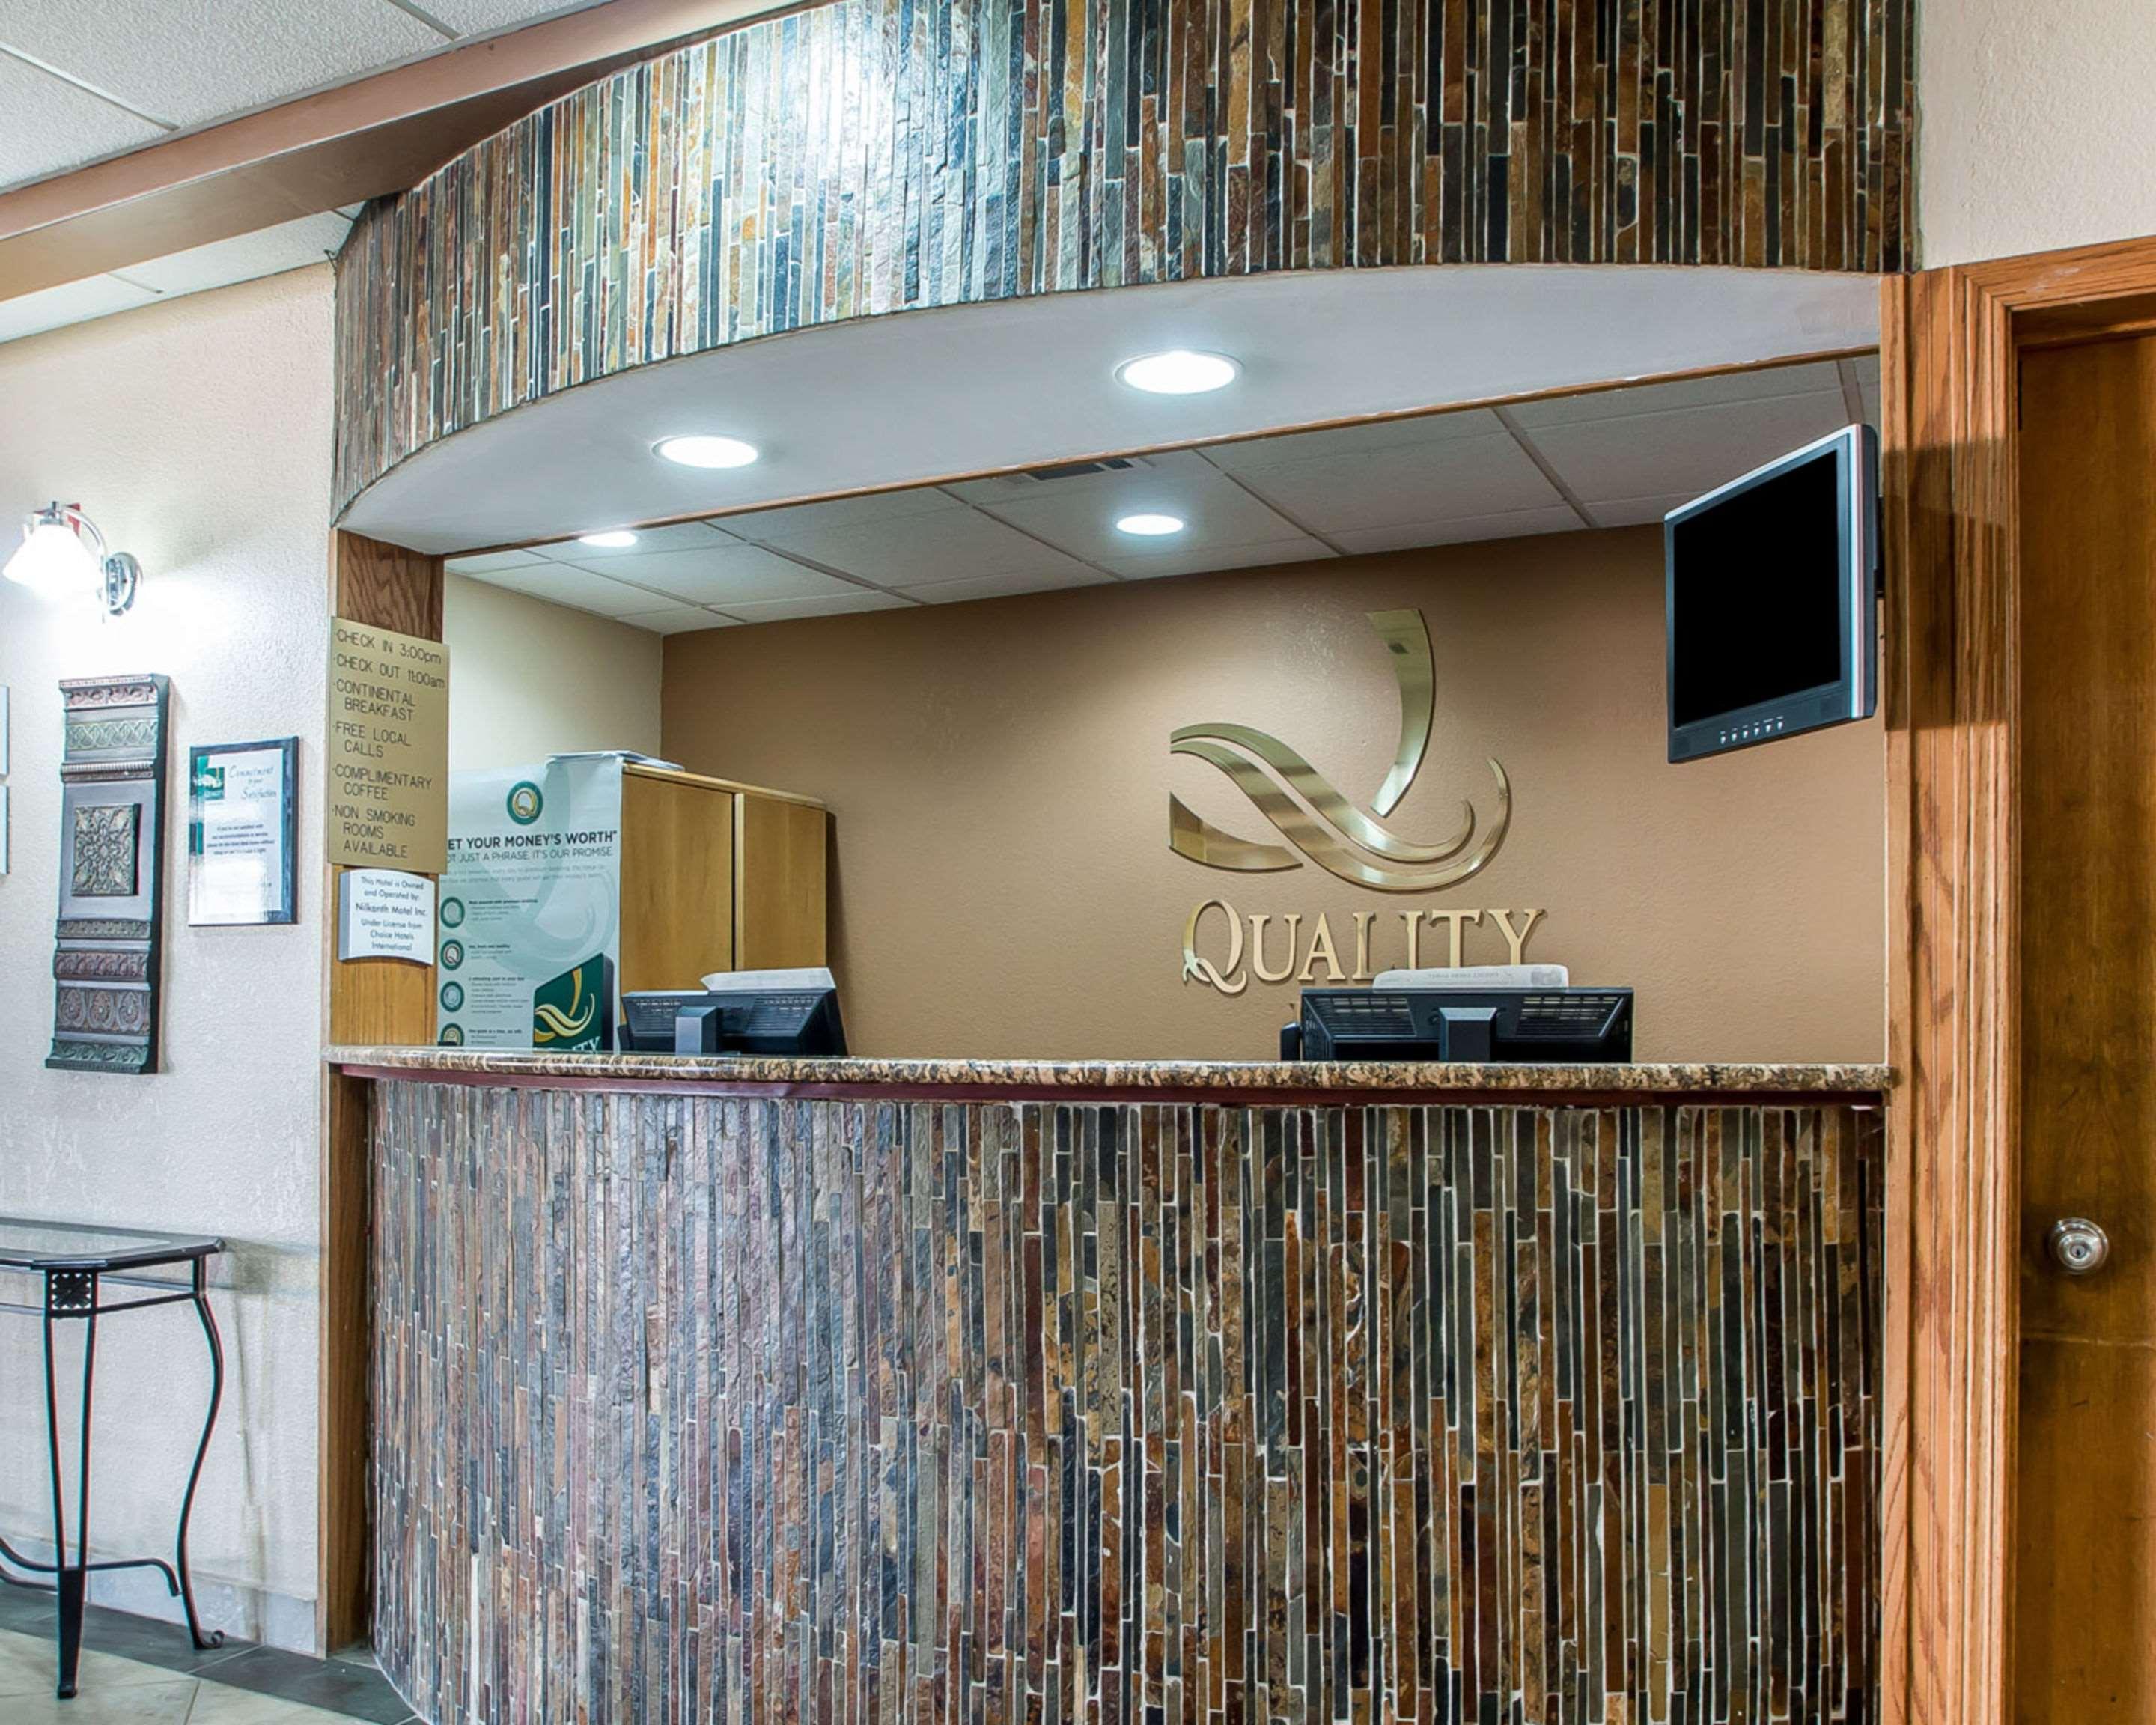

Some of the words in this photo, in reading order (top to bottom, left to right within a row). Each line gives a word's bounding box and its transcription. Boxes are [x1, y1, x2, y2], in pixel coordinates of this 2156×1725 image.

[336, 628, 375, 649] CHECK
[383, 639, 393, 653] IN
[400, 643, 442, 665] 3:00pm
[336, 653, 373, 673] CHECK
[379, 663, 401, 679] OUT
[408, 669, 445, 689] 11:00am
[336, 678, 416, 706] CONTINENTAL
[344, 697, 414, 721] BREAKFAST
[335, 721, 366, 739] FREE
[373, 728, 412, 747] LOCAL
[344, 740, 384, 758] CALLS
[335, 764, 433, 790] COMPLIMENTARY
[344, 782, 389, 800] COFFEE
[335, 804, 359, 819] NON
[366, 809, 415, 827] SMOKING
[343, 822, 384, 839] ROOMS
[343, 839, 408, 858] AVAILABLE
[448, 838, 463, 851] ET
[466, 836, 501, 849] YOUR
[504, 833, 561, 847] MONEY'S
[460, 852, 480, 862] JUST
[483, 852, 490, 861] A
[549, 848, 570, 859] OUR
[360, 876, 374, 886] This
[401, 880, 424, 890] Owned
[378, 889, 409, 900] Operated
[360, 918, 381, 927] Under
[407, 921, 423, 930] from
[370, 929, 393, 939] Choice
[371, 941, 413, 951] International
[1183, 898, 1543, 994] QUALITY
